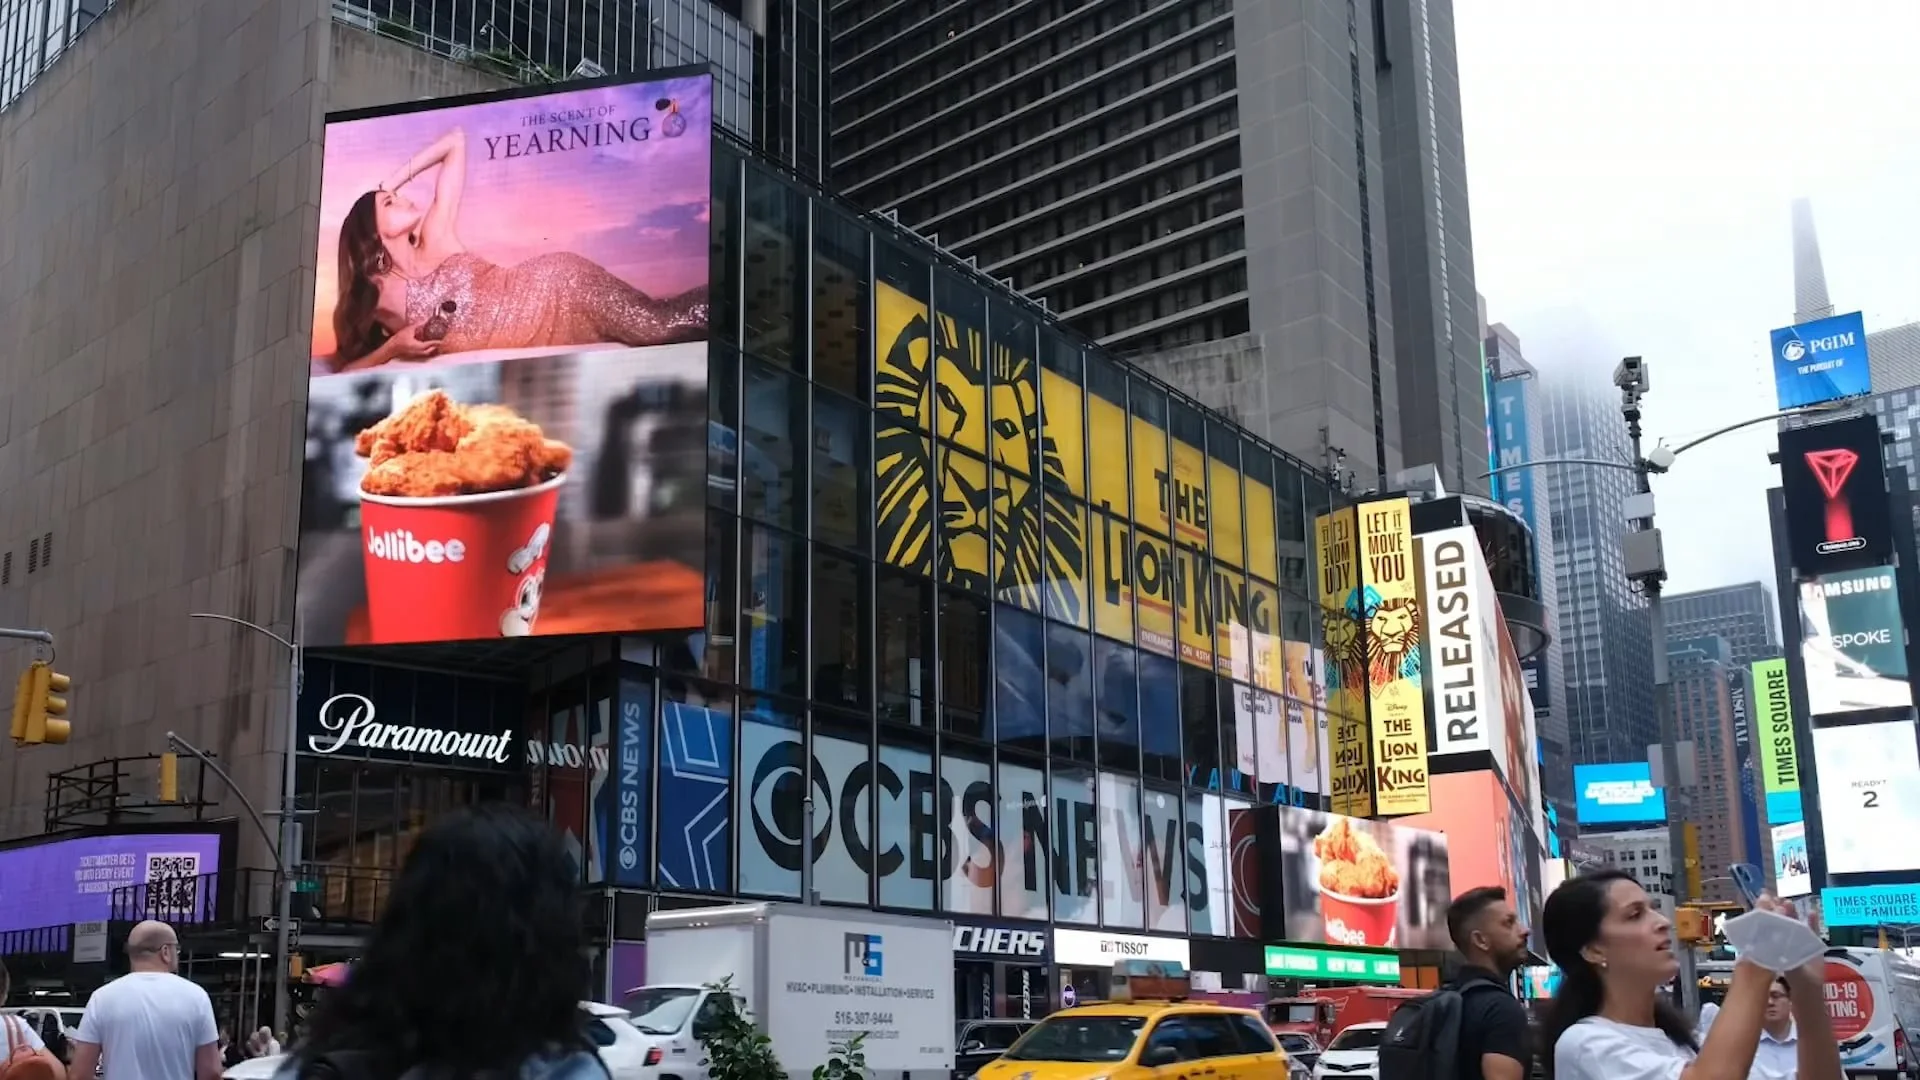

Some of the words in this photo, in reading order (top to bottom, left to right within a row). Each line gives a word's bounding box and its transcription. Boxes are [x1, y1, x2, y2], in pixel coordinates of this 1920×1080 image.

[520, 113, 546, 127] THE
[550, 107, 597, 123] SCENT
[598, 104, 616, 117] OF
[484, 117, 652, 161] YEARNING
[1810, 332, 1855, 354] PGIM
[1500, 396, 1524, 516] TIMES
[1155, 468, 1207, 530] THE
[1366, 512, 1388, 533] LET
[1393, 512, 1402, 528] IT
[368, 525, 466, 564] Jollibee
[1368, 532, 1404, 555] MOVE
[1102, 499, 1188, 609] LION
[1191, 541, 1270, 639] KING
[1370, 553, 1405, 583] YOU
[1434, 539, 1479, 742] RELEASED
[1767, 669, 1790, 733] SQUARE
[308, 693, 513, 763] Paramount
[1384, 718, 1412, 733] THE
[622, 702, 640, 786] NEWS
[1380, 740, 1418, 763] LION
[1775, 740, 1795, 785] TIMES
[1377, 766, 1425, 792] KING
[1862, 790, 1880, 808] 2
[620, 791, 638, 845] CBS
[840, 760, 1005, 889] CBS
[1021, 790, 1210, 913] NEWS
[1834, 896, 1867, 907] TIMES
[1870, 893, 1917, 905] SQUARE
[1865, 905, 1919, 917] FAMILIES
[952, 926, 1045, 956] CHERS
[1115, 941, 1149, 955] TISSOT
[786, 981, 808, 994] HVAC
[811, 982, 850, 995] PLUMBING
[854, 985, 903, 998] INSTALLATION
[906, 988, 935, 999] SERVICE
[834, 1011, 894, 1025] 516-307-9444
